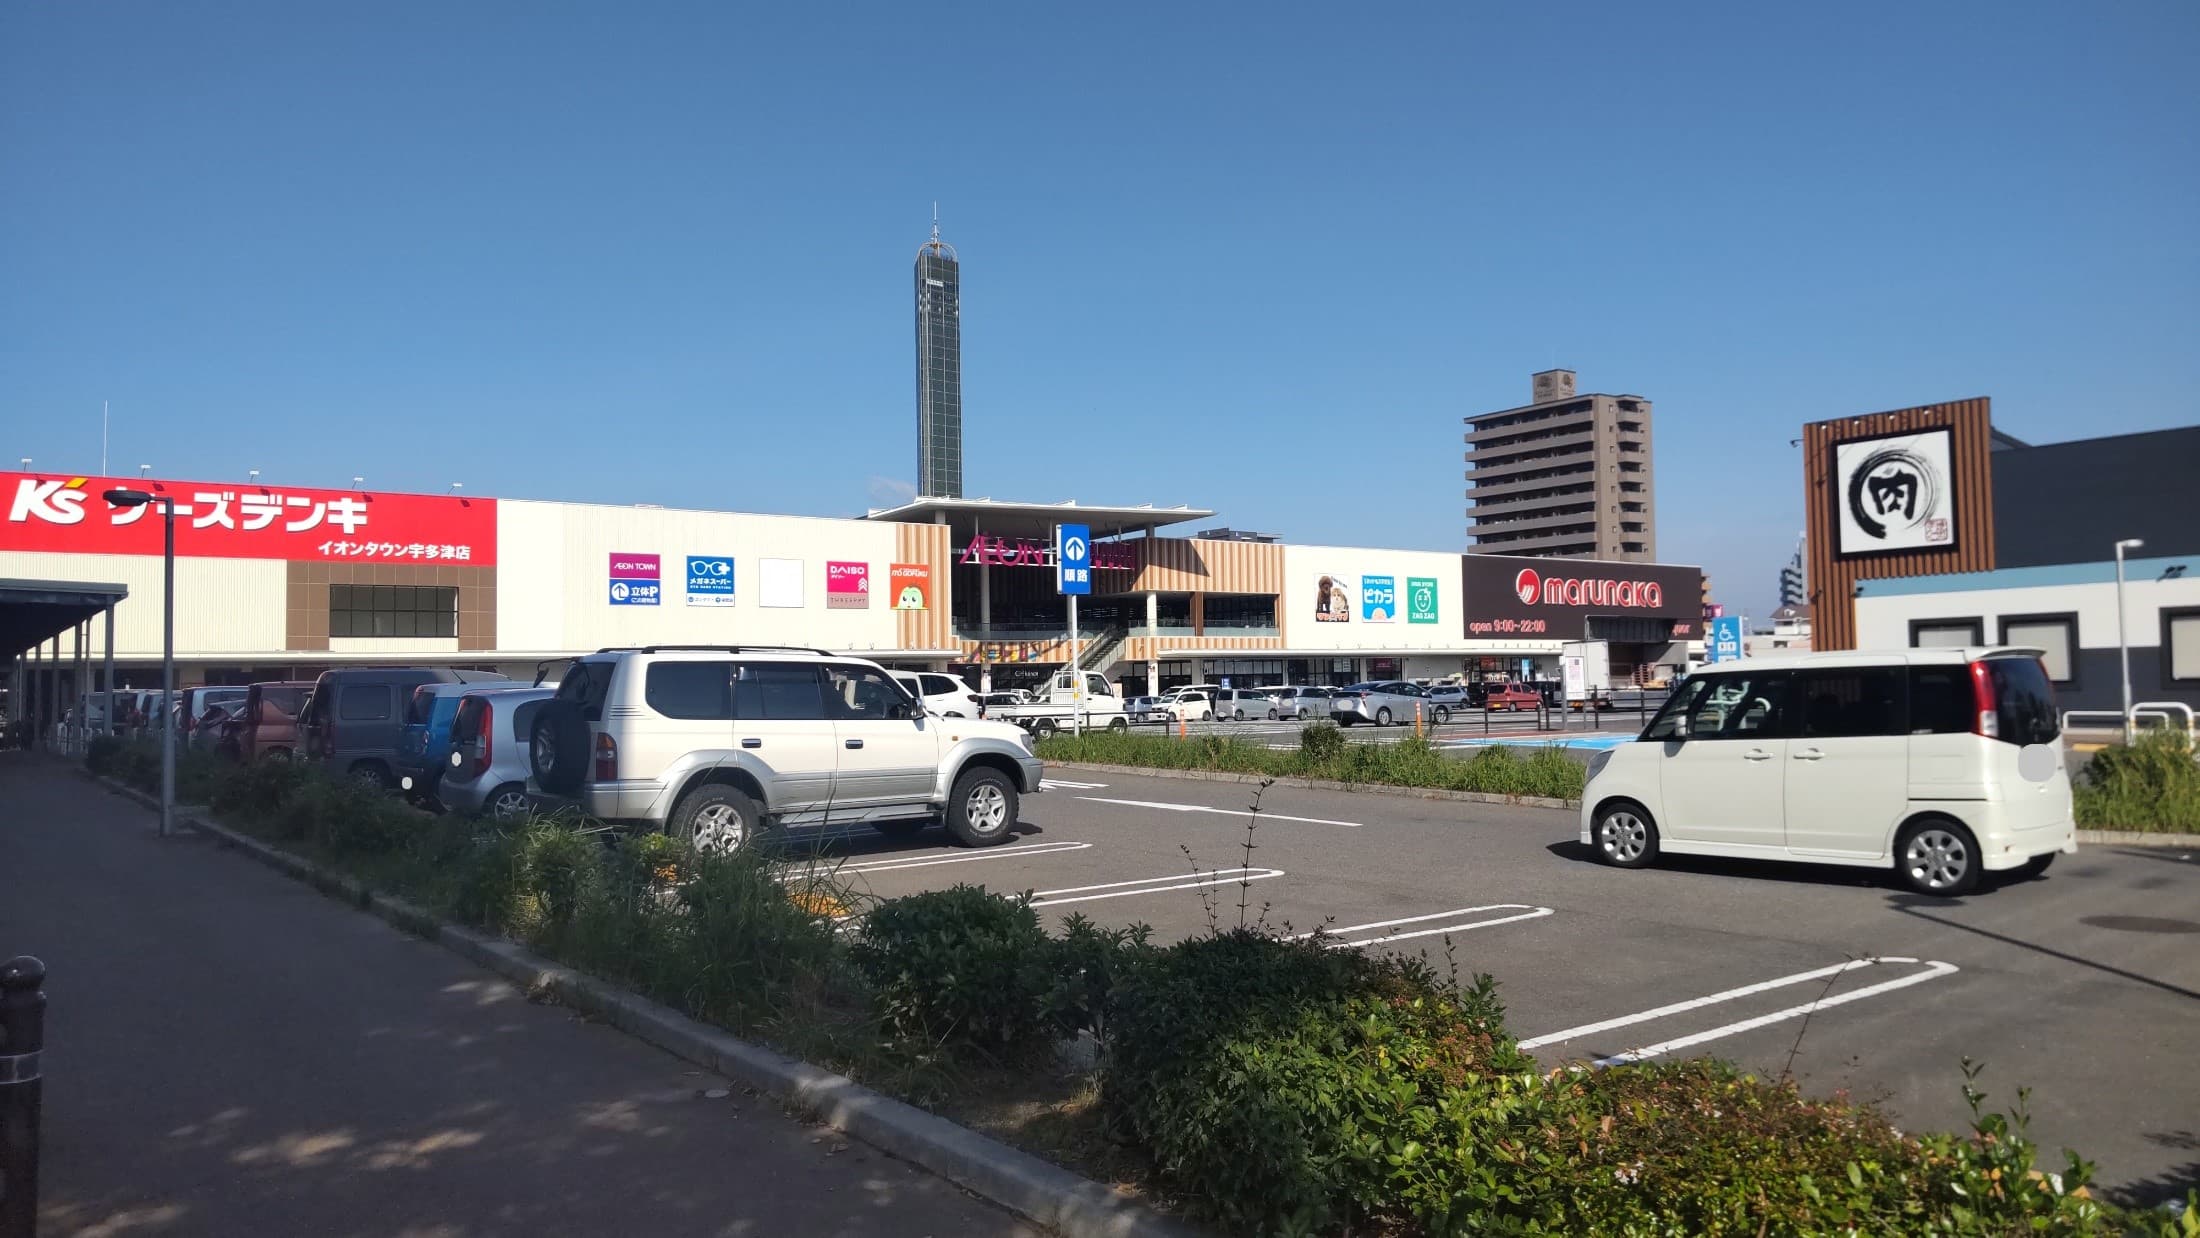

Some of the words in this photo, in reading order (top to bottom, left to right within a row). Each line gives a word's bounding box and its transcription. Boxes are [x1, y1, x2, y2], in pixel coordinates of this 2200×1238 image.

[9, 478, 88, 525] K's
[318, 541, 471, 560] イオンタウン宇多津店
[830, 566, 865, 575] DAISO
[1064, 568, 1088, 583] 順路
[690, 577, 732, 585] メガネスーパー
[1363, 588, 1393, 604] ピカラ
[1544, 577, 1663, 608] marunaka
[1470, 622, 1493, 634] open
